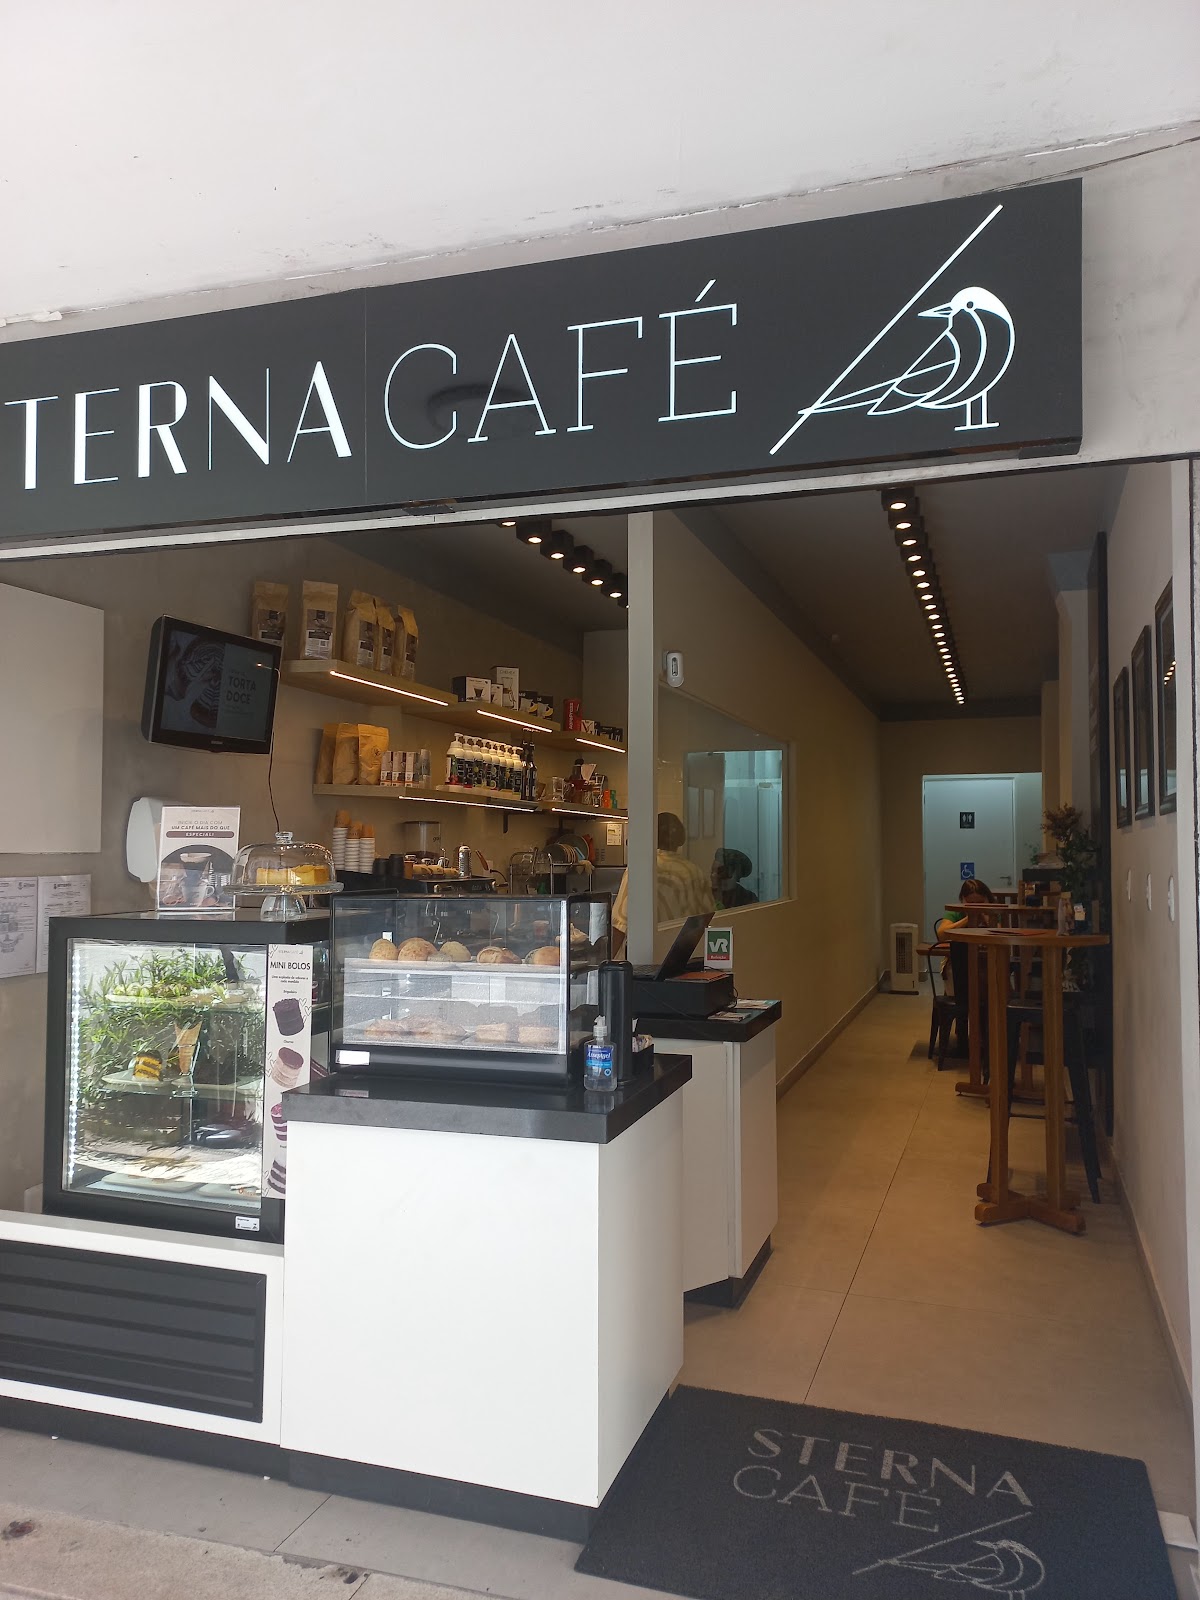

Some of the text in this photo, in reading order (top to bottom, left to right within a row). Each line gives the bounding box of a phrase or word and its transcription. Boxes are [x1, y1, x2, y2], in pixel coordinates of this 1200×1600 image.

[4, 279, 737, 490] TERNA CAFÉ
[226, 691, 251, 704] DOCE
[229, 677, 256, 691] TORTA
[270, 961, 311, 970] MINI BOLOS
[747, 1428, 1034, 1507] STERNA
[733, 1464, 942, 1533] CAFÉ
